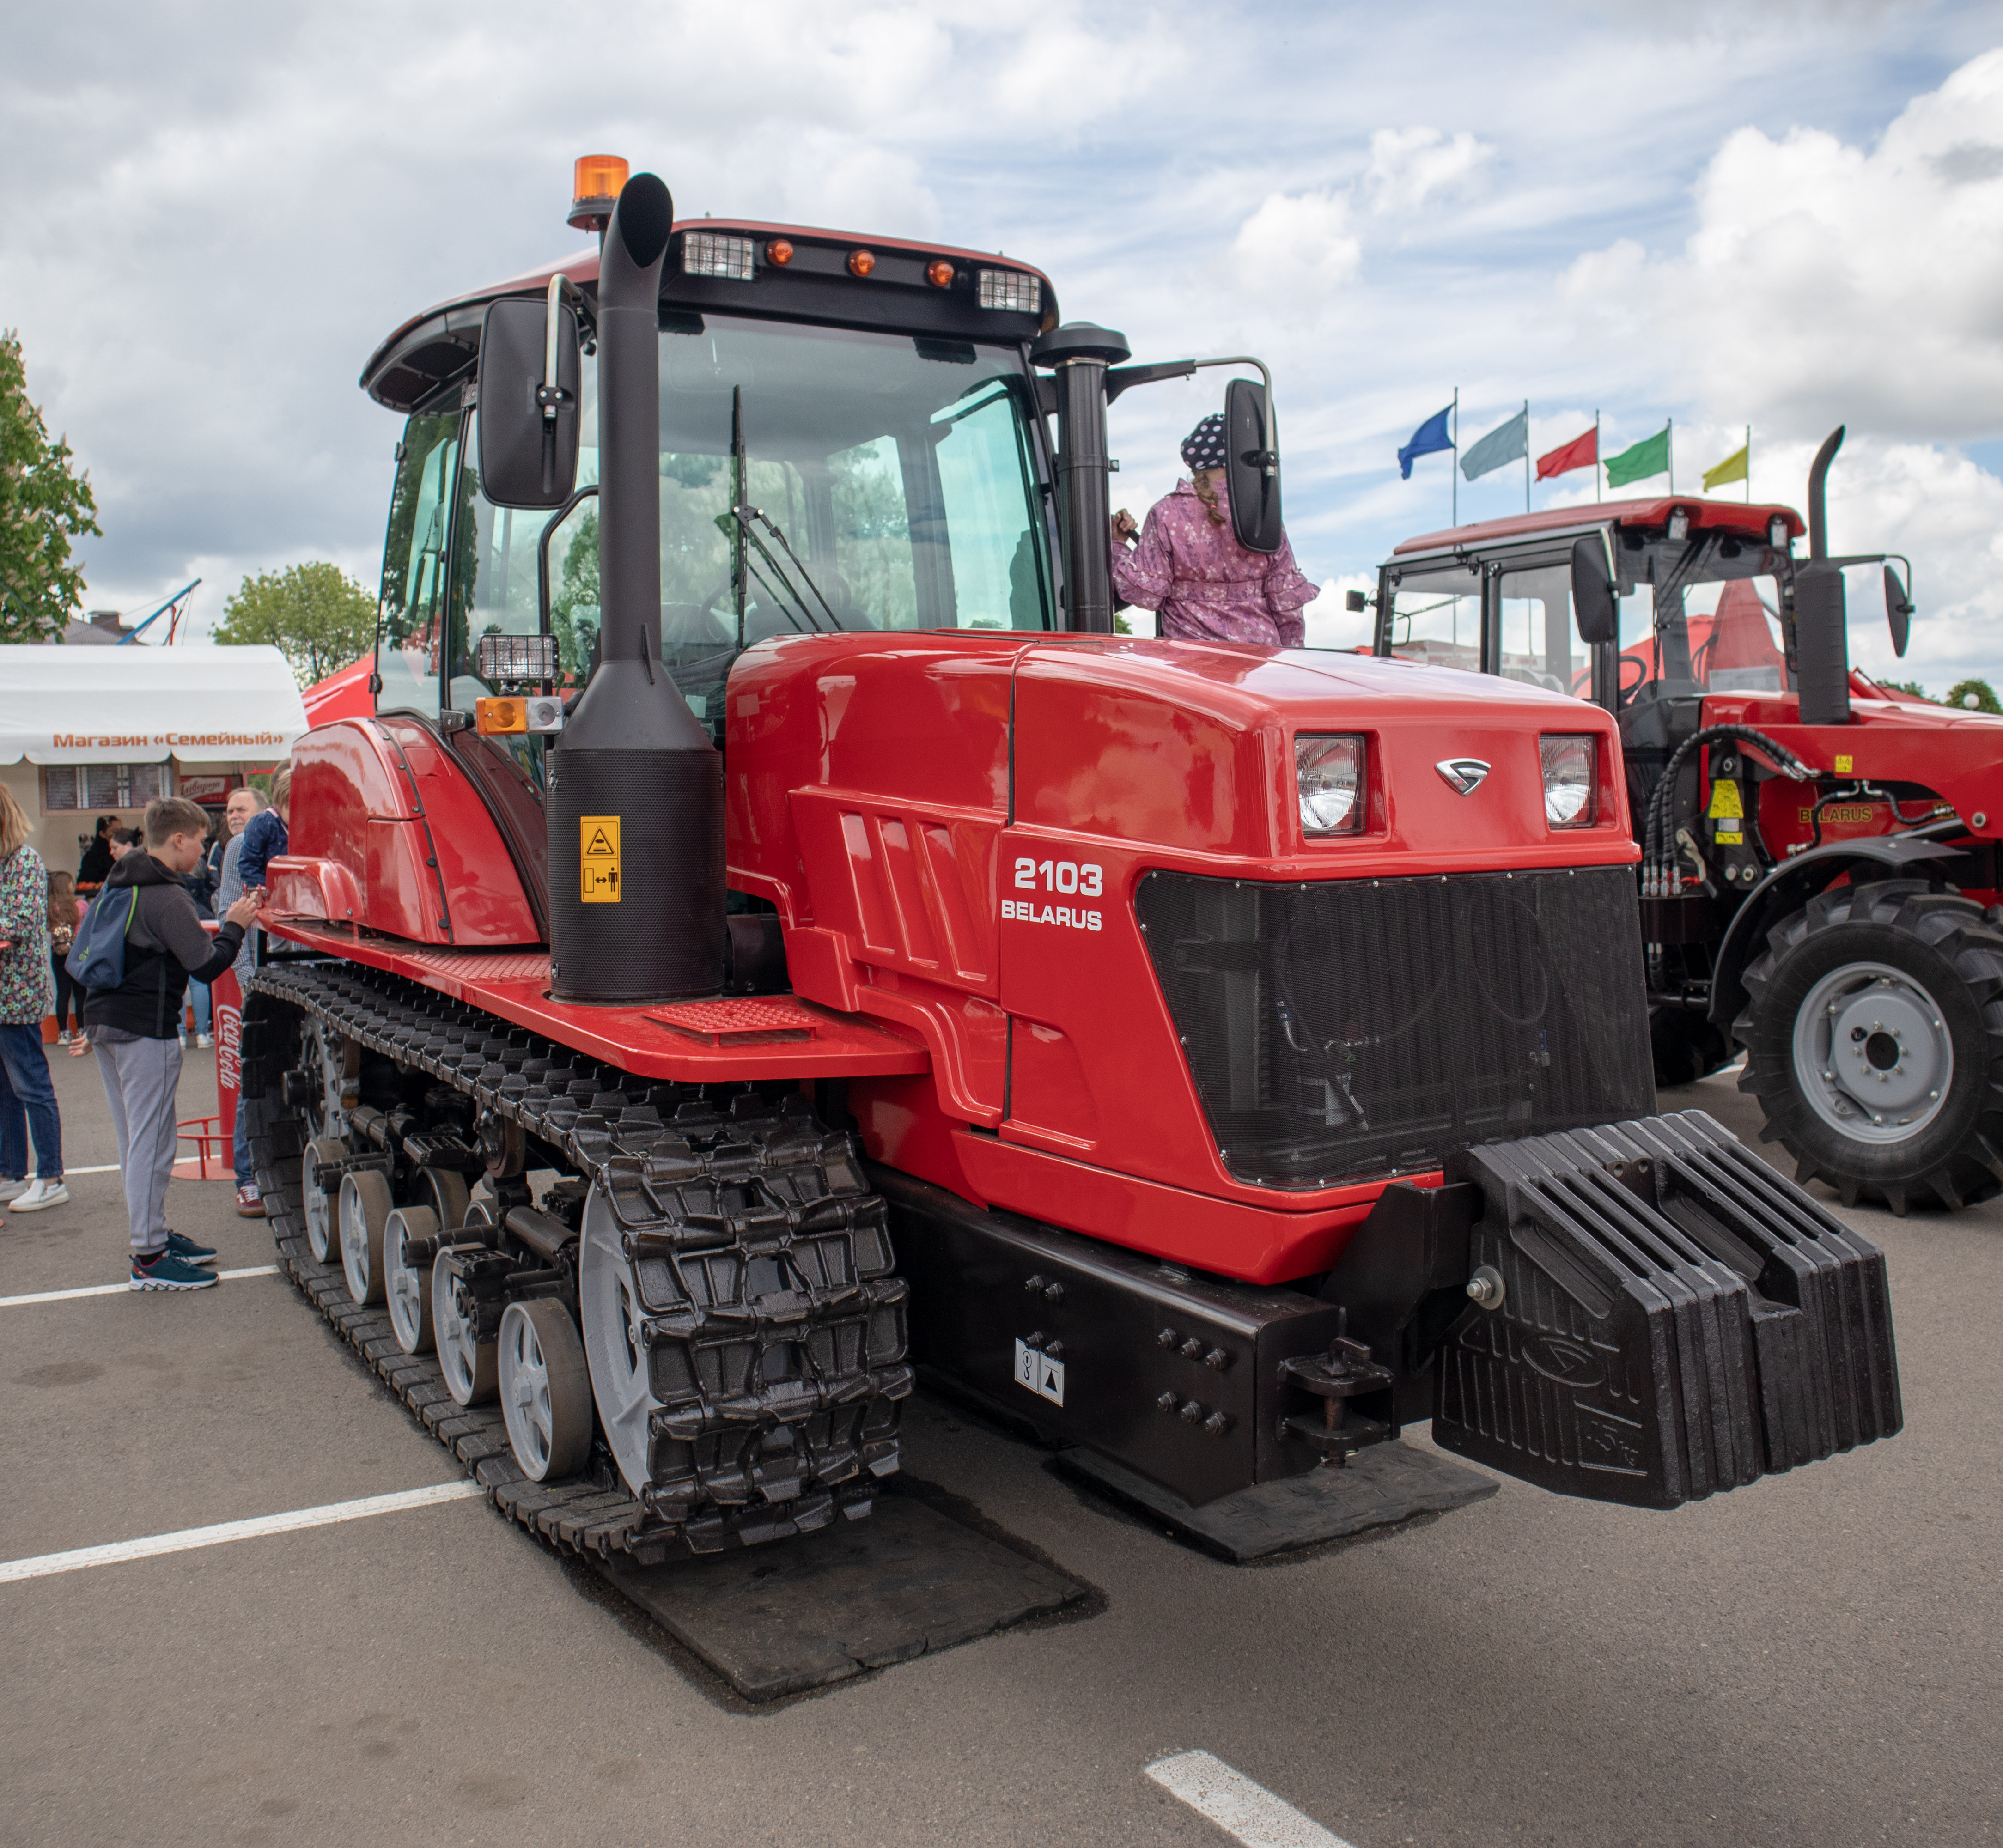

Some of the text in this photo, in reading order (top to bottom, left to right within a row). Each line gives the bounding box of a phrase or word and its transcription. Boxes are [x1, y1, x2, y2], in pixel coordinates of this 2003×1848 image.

[53, 731, 283, 748] Магазин «Семейный»
[1800, 807, 1871, 822] BLARUS
[1015, 857, 1102, 897] 2103
[1002, 900, 1102, 931] BELARUS
